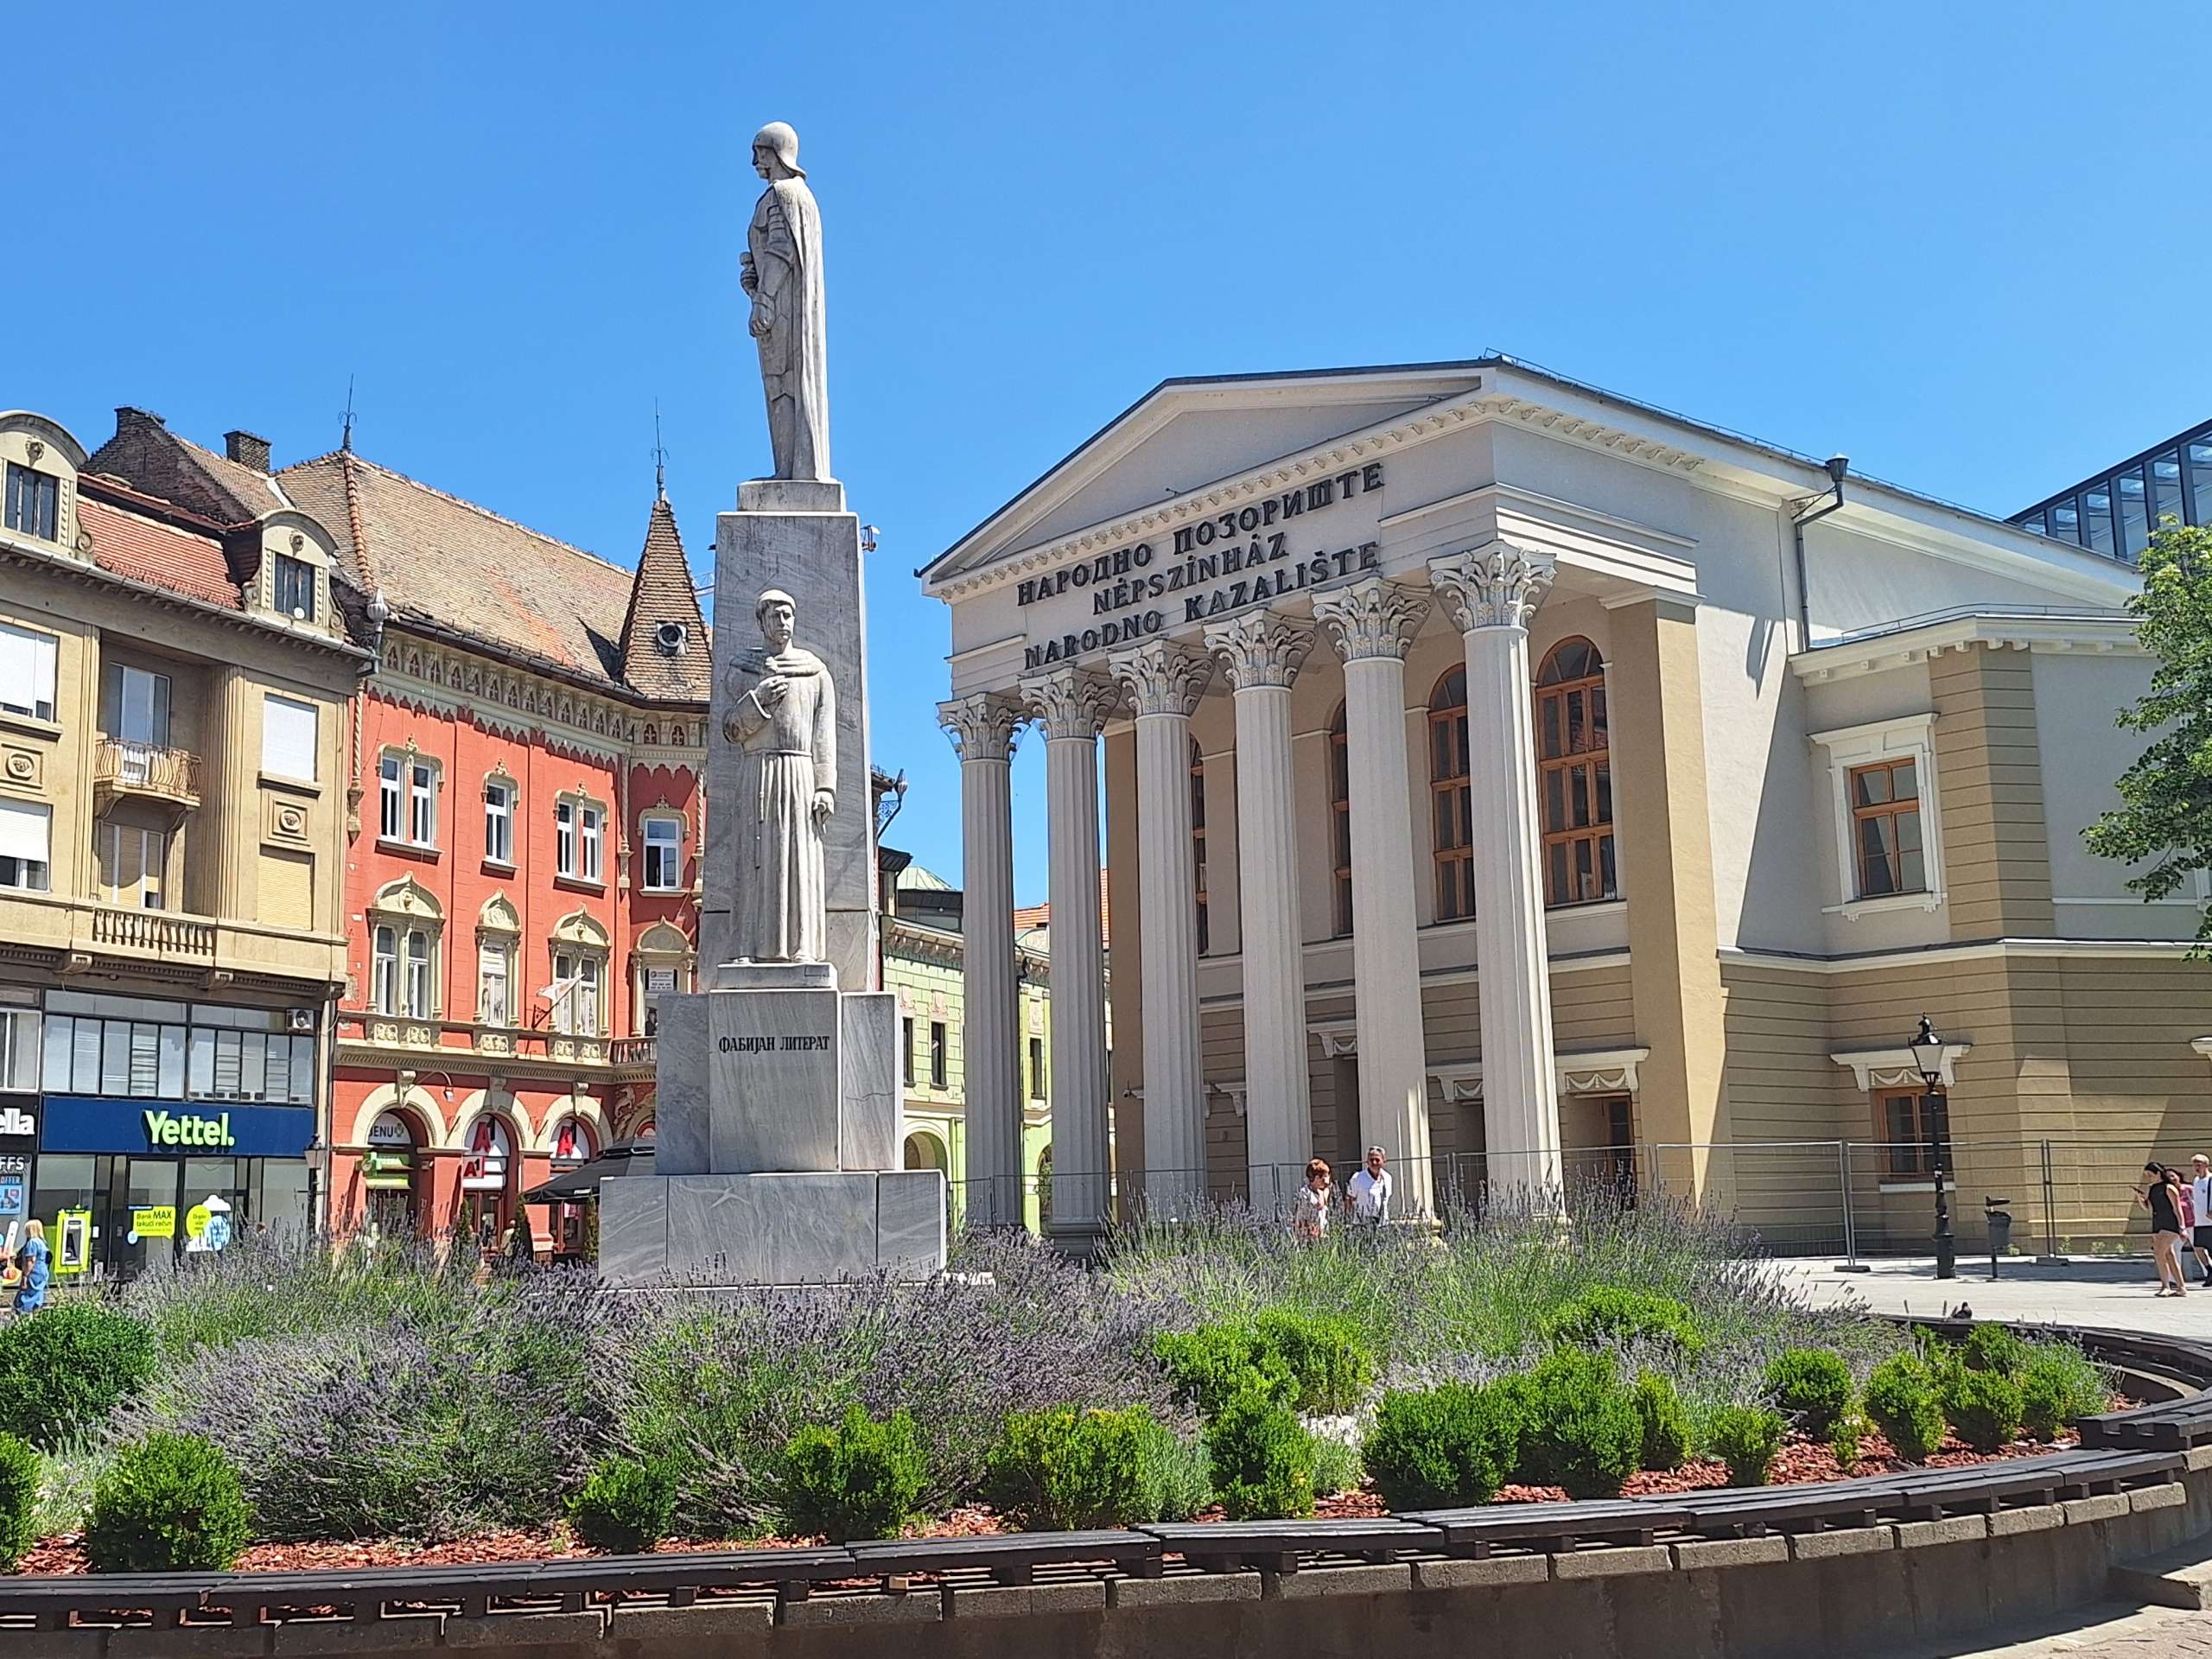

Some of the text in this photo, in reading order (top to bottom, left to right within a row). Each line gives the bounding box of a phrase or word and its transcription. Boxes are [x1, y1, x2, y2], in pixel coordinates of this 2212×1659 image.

[1017, 462, 1384, 607] НАРОДНО ПОЗОРИШТЕ
[1093, 531, 1289, 615] NÉPSZÍNHÁZ
[1024, 541, 1379, 671] NARODNO KAZALIŠTE
[718, 1035, 830, 1055] ФАБИЈАН ЛИТЕРАТ
[143, 1109, 236, 1147] Yettel.
[472, 1116, 496, 1154] A1
[556, 1121, 577, 1156] A1
[463, 1158, 480, 1177] A1
[153, 1210, 172, 1219] MAX
